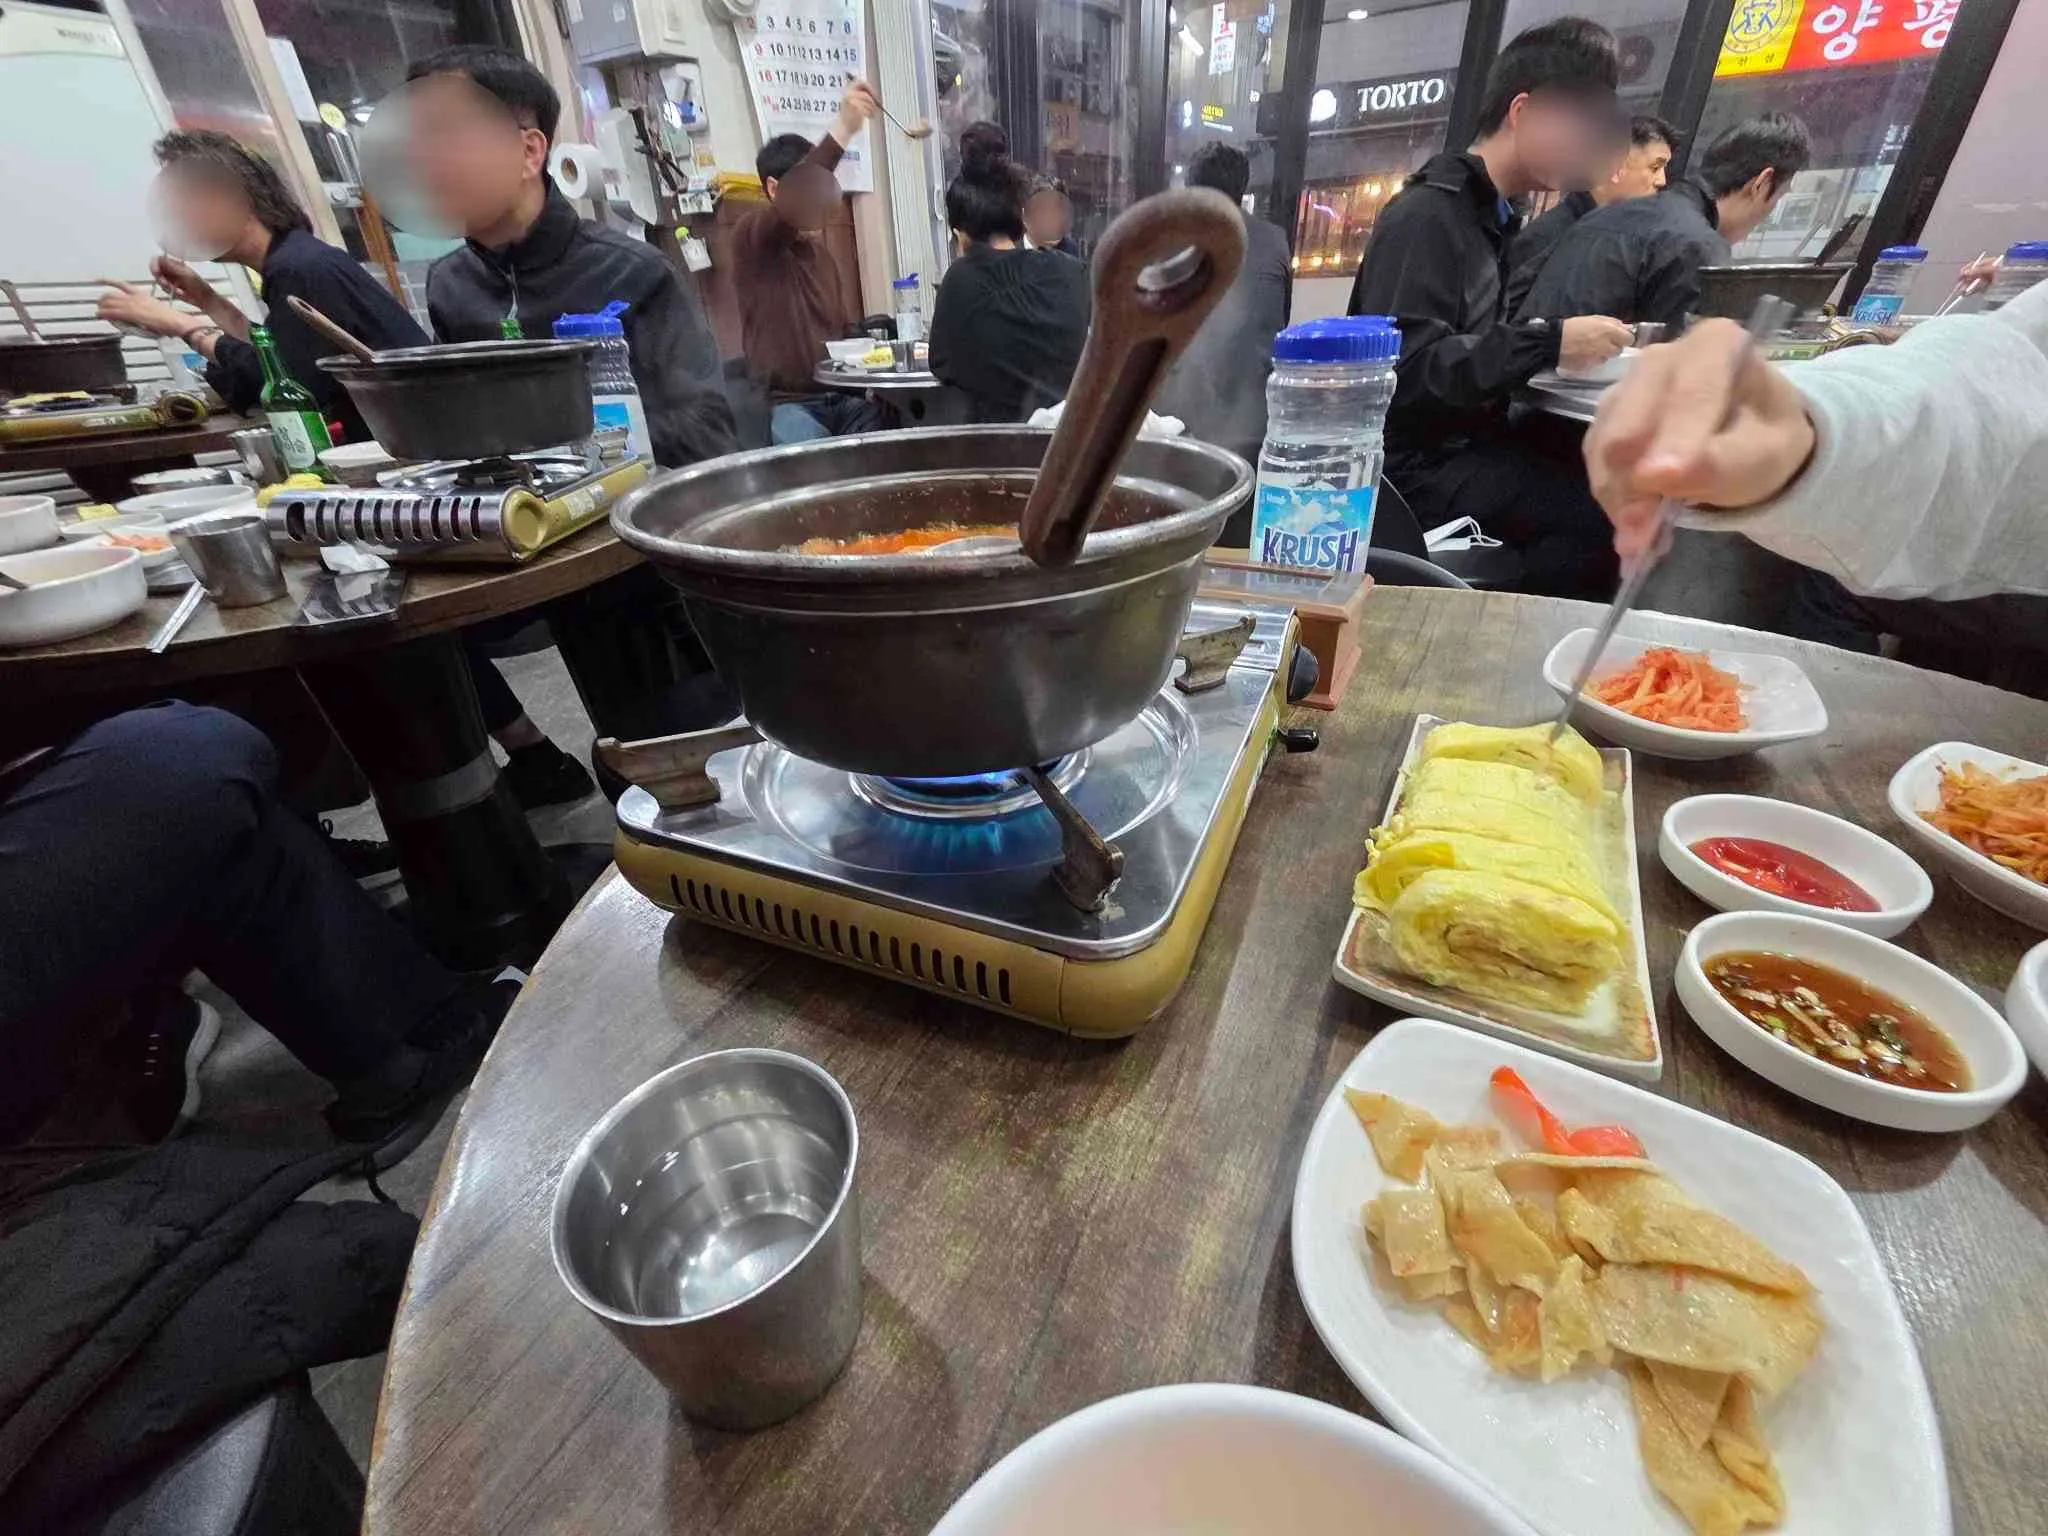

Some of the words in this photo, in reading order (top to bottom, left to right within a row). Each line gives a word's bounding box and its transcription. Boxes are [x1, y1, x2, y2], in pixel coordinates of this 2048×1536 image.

[767, 16, 775, 30] 3
[785, 16, 791, 29] 4
[796, 18, 802, 31] 5
[809, 20, 816, 33] 6
[826, 20, 833, 34] 7
[755, 43, 763, 56] 9
[770, 43, 783, 56] 10
[787, 44, 796, 57] 11
[797, 46, 806, 59] 12
[809, 48, 822, 60] 13
[826, 48, 840, 61] 14
[843, 48, 857, 61] 15
[759, 70, 773, 82] 16
[776, 70, 787, 82] 17
[811, 74, 825, 86] 20
[829, 75, 843, 87] 21
[1358, 78, 1445, 112] TORTO
[780, 97, 792, 109] 24
[814, 100, 826, 112] 27
[1855, 309, 1892, 325] KRUSH
[1262, 527, 1360, 573] KRUSH
